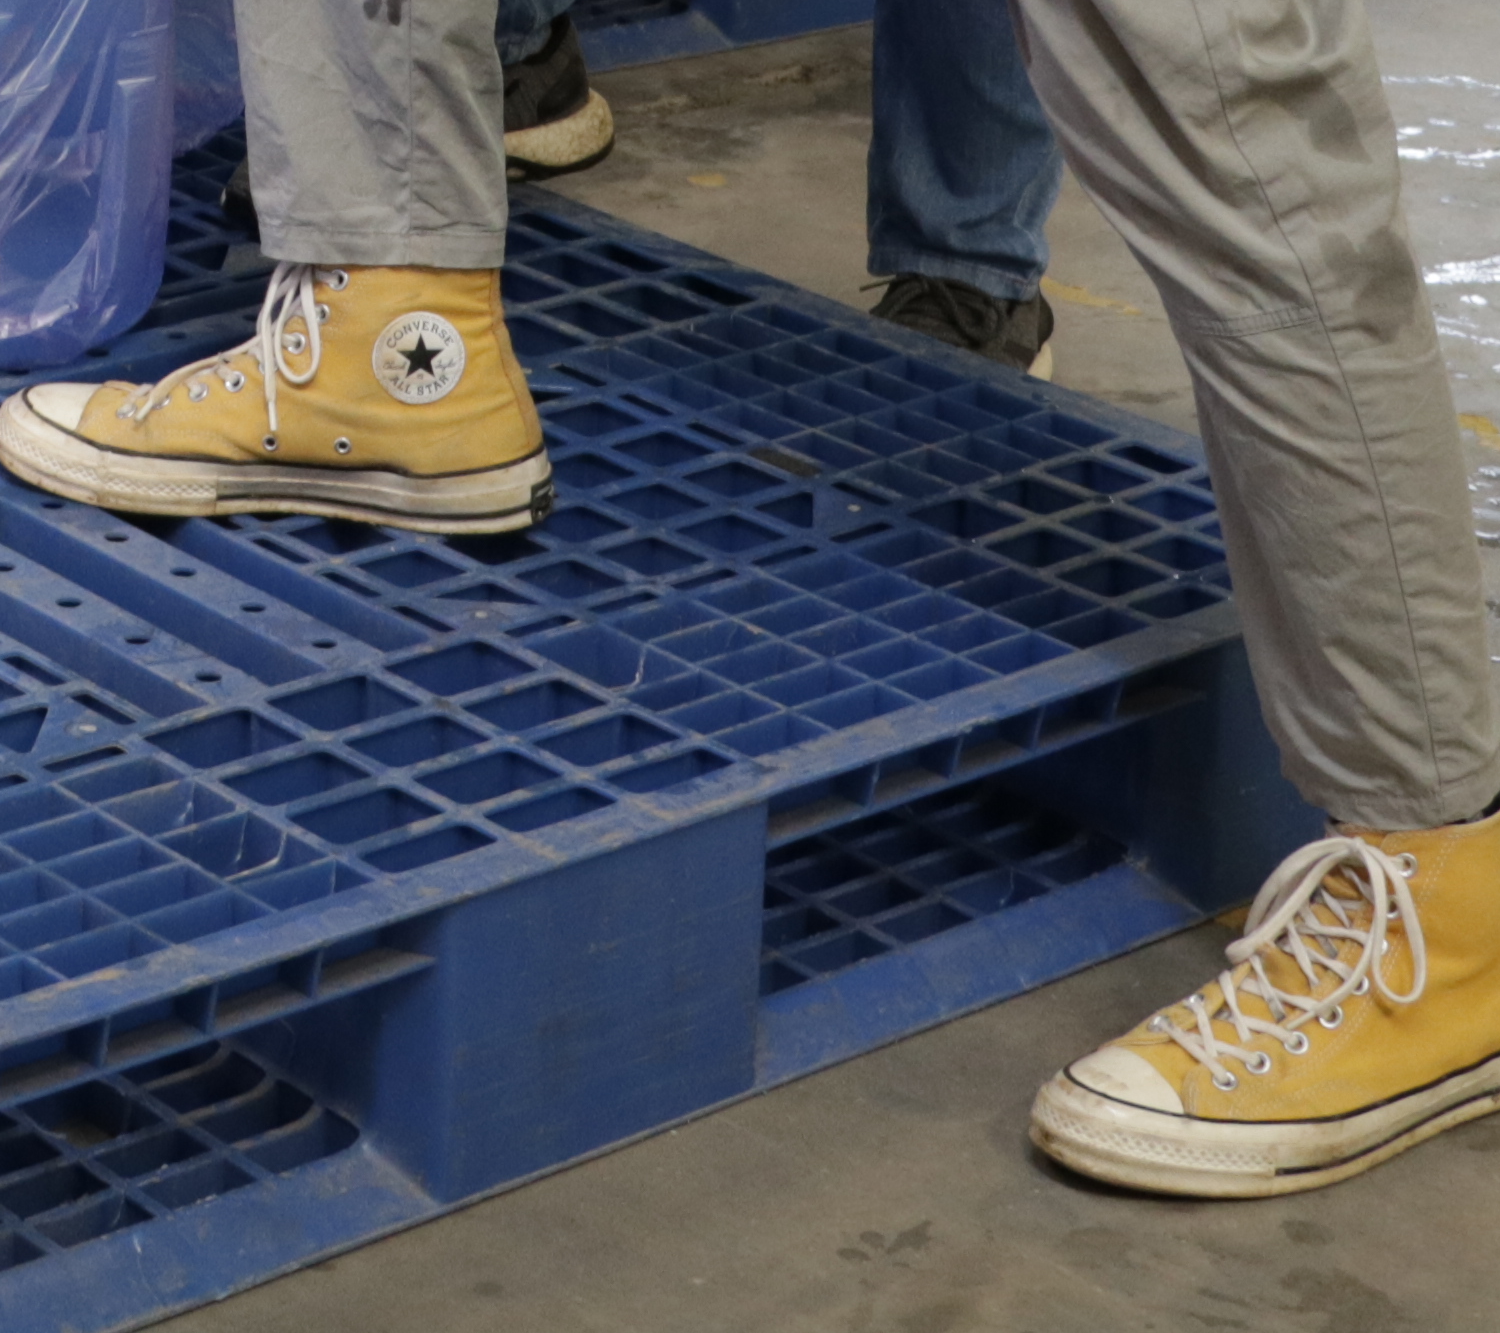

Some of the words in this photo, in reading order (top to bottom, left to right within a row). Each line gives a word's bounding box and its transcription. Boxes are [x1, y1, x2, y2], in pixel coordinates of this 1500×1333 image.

[385, 319, 455, 350] CONVERSE
[389, 375, 413, 395] ALL
[416, 374, 450, 397] STAR
